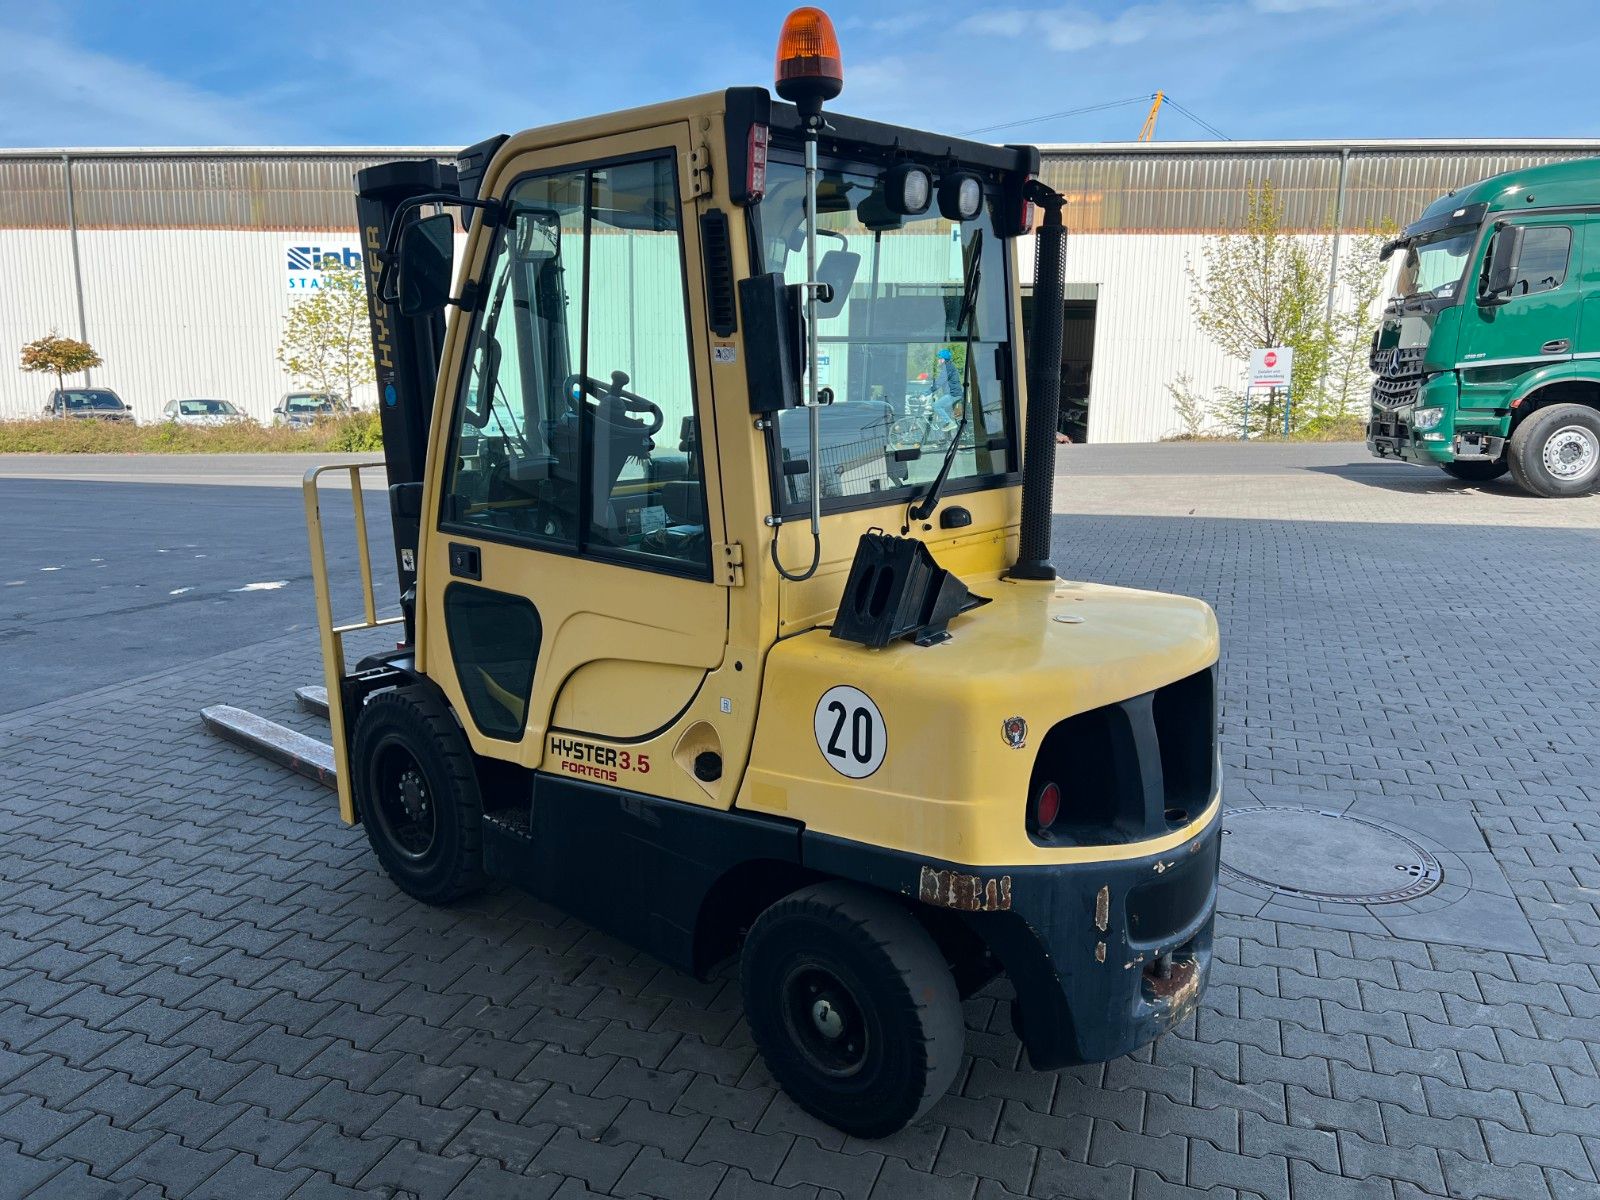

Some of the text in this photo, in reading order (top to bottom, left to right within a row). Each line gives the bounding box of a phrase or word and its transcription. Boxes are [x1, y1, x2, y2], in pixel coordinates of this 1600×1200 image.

[366, 226, 394, 368] HYSTER
[551, 737, 651, 774] HYSTER 3.5
[827, 700, 873, 764] 20
[561, 760, 618, 783] FORTENS
